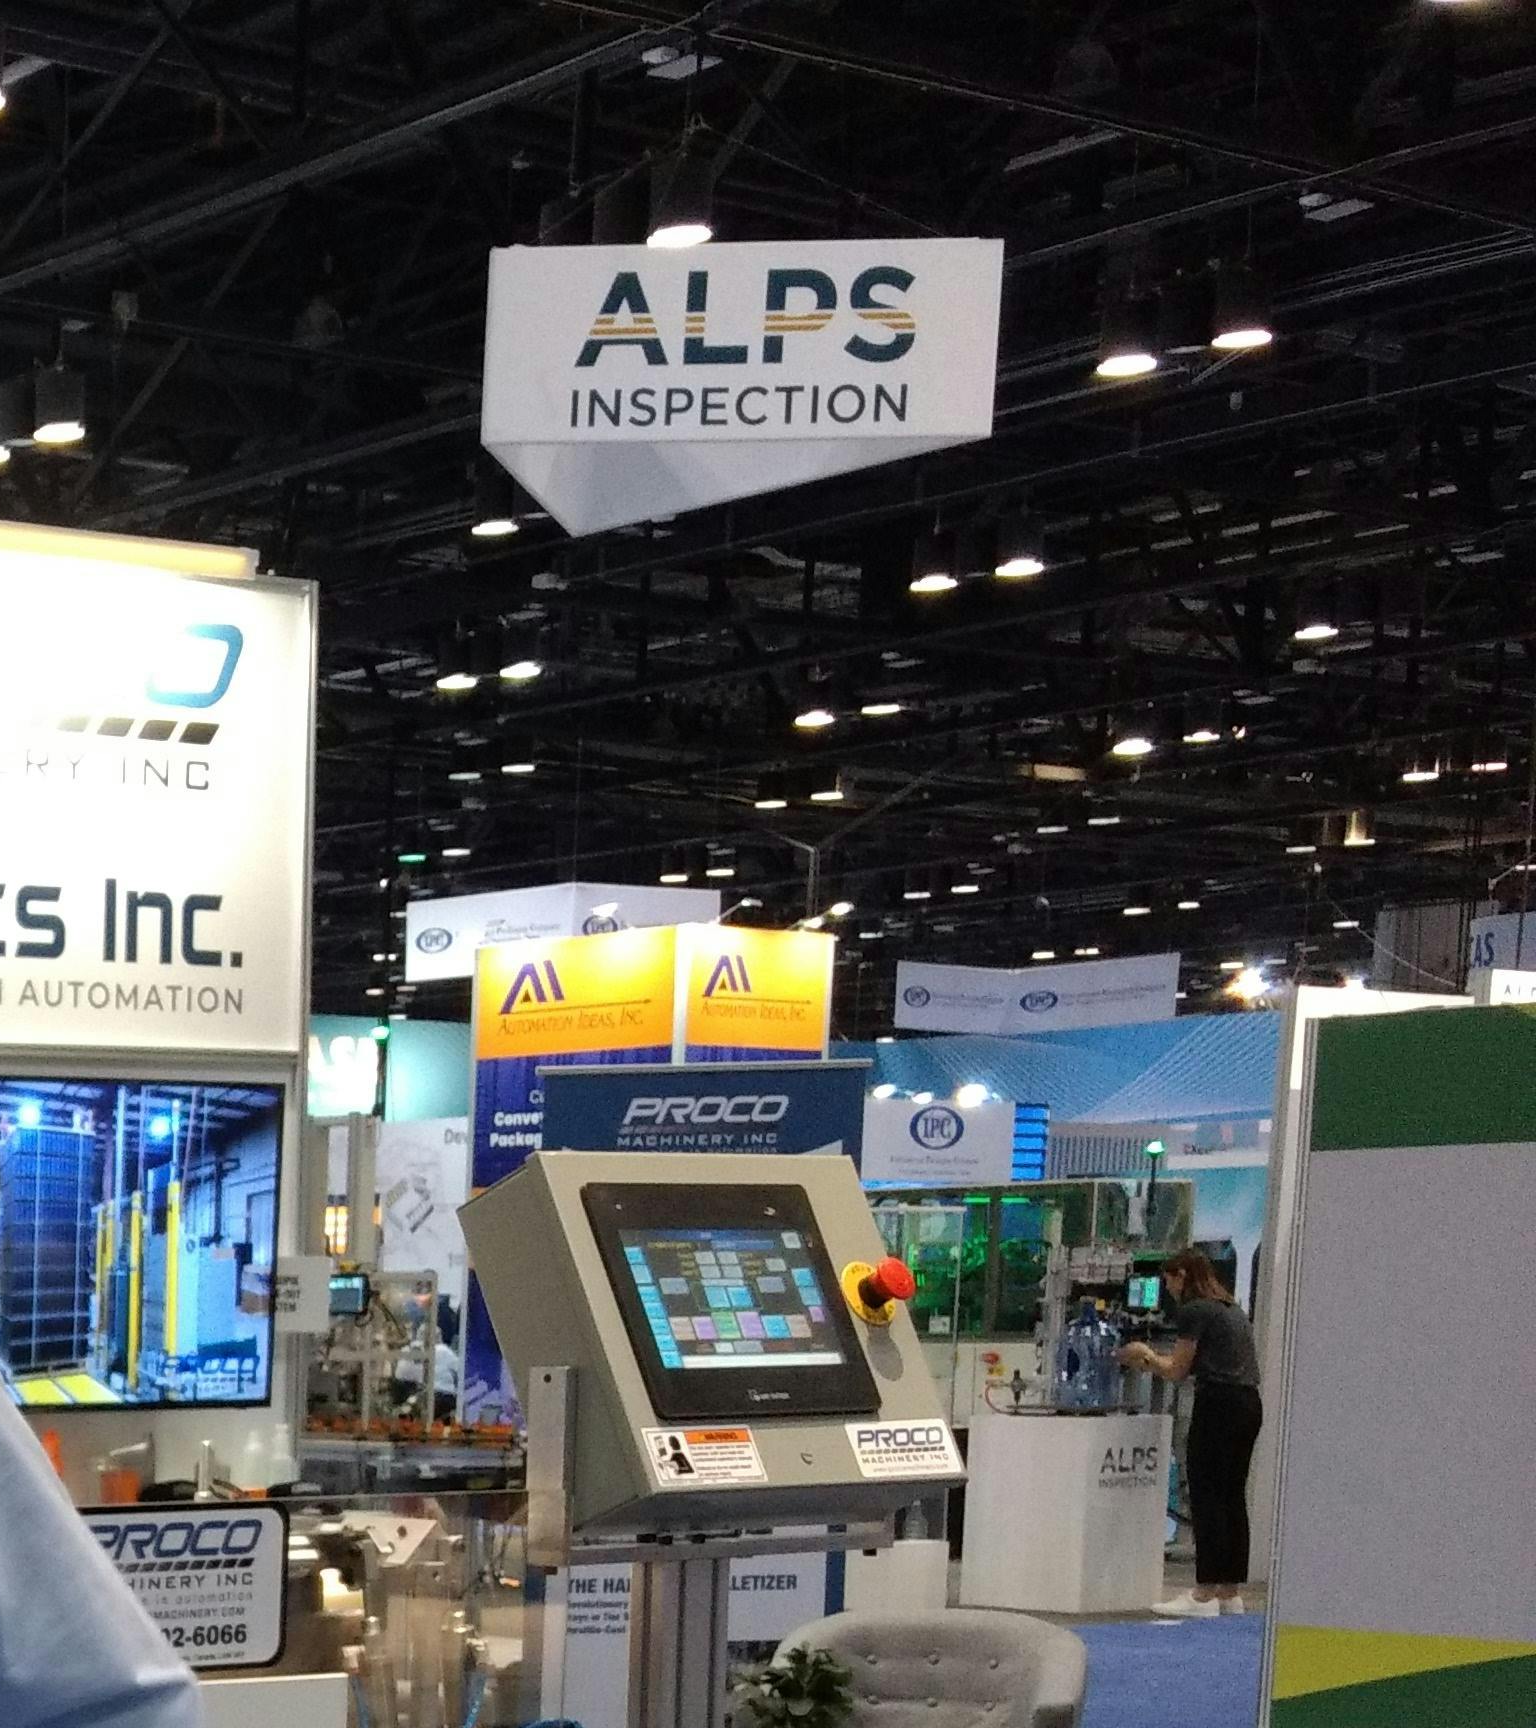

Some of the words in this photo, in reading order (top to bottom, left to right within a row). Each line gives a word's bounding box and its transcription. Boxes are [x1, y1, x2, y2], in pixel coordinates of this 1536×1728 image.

[574, 266, 917, 367] ALPS
[570, 383, 908, 428] INSPECTION
[121, 755, 211, 791] INC
[102, 877, 244, 969] Inc.
[18, 978, 244, 1015] AUTOMATION
[622, 1095, 789, 1125] PROCO
[616, 1134, 734, 1147] MACHINERY
[744, 1133, 777, 1145] INC
[857, 1427, 944, 1449] PROCO
[862, 1454, 925, 1465] MACHINERY
[929, 1452, 949, 1462] INC
[1100, 1446, 1159, 1474] ALPS
[1098, 1475, 1157, 1489] INSPECTION
[217, 1572, 254, 1587] INC
